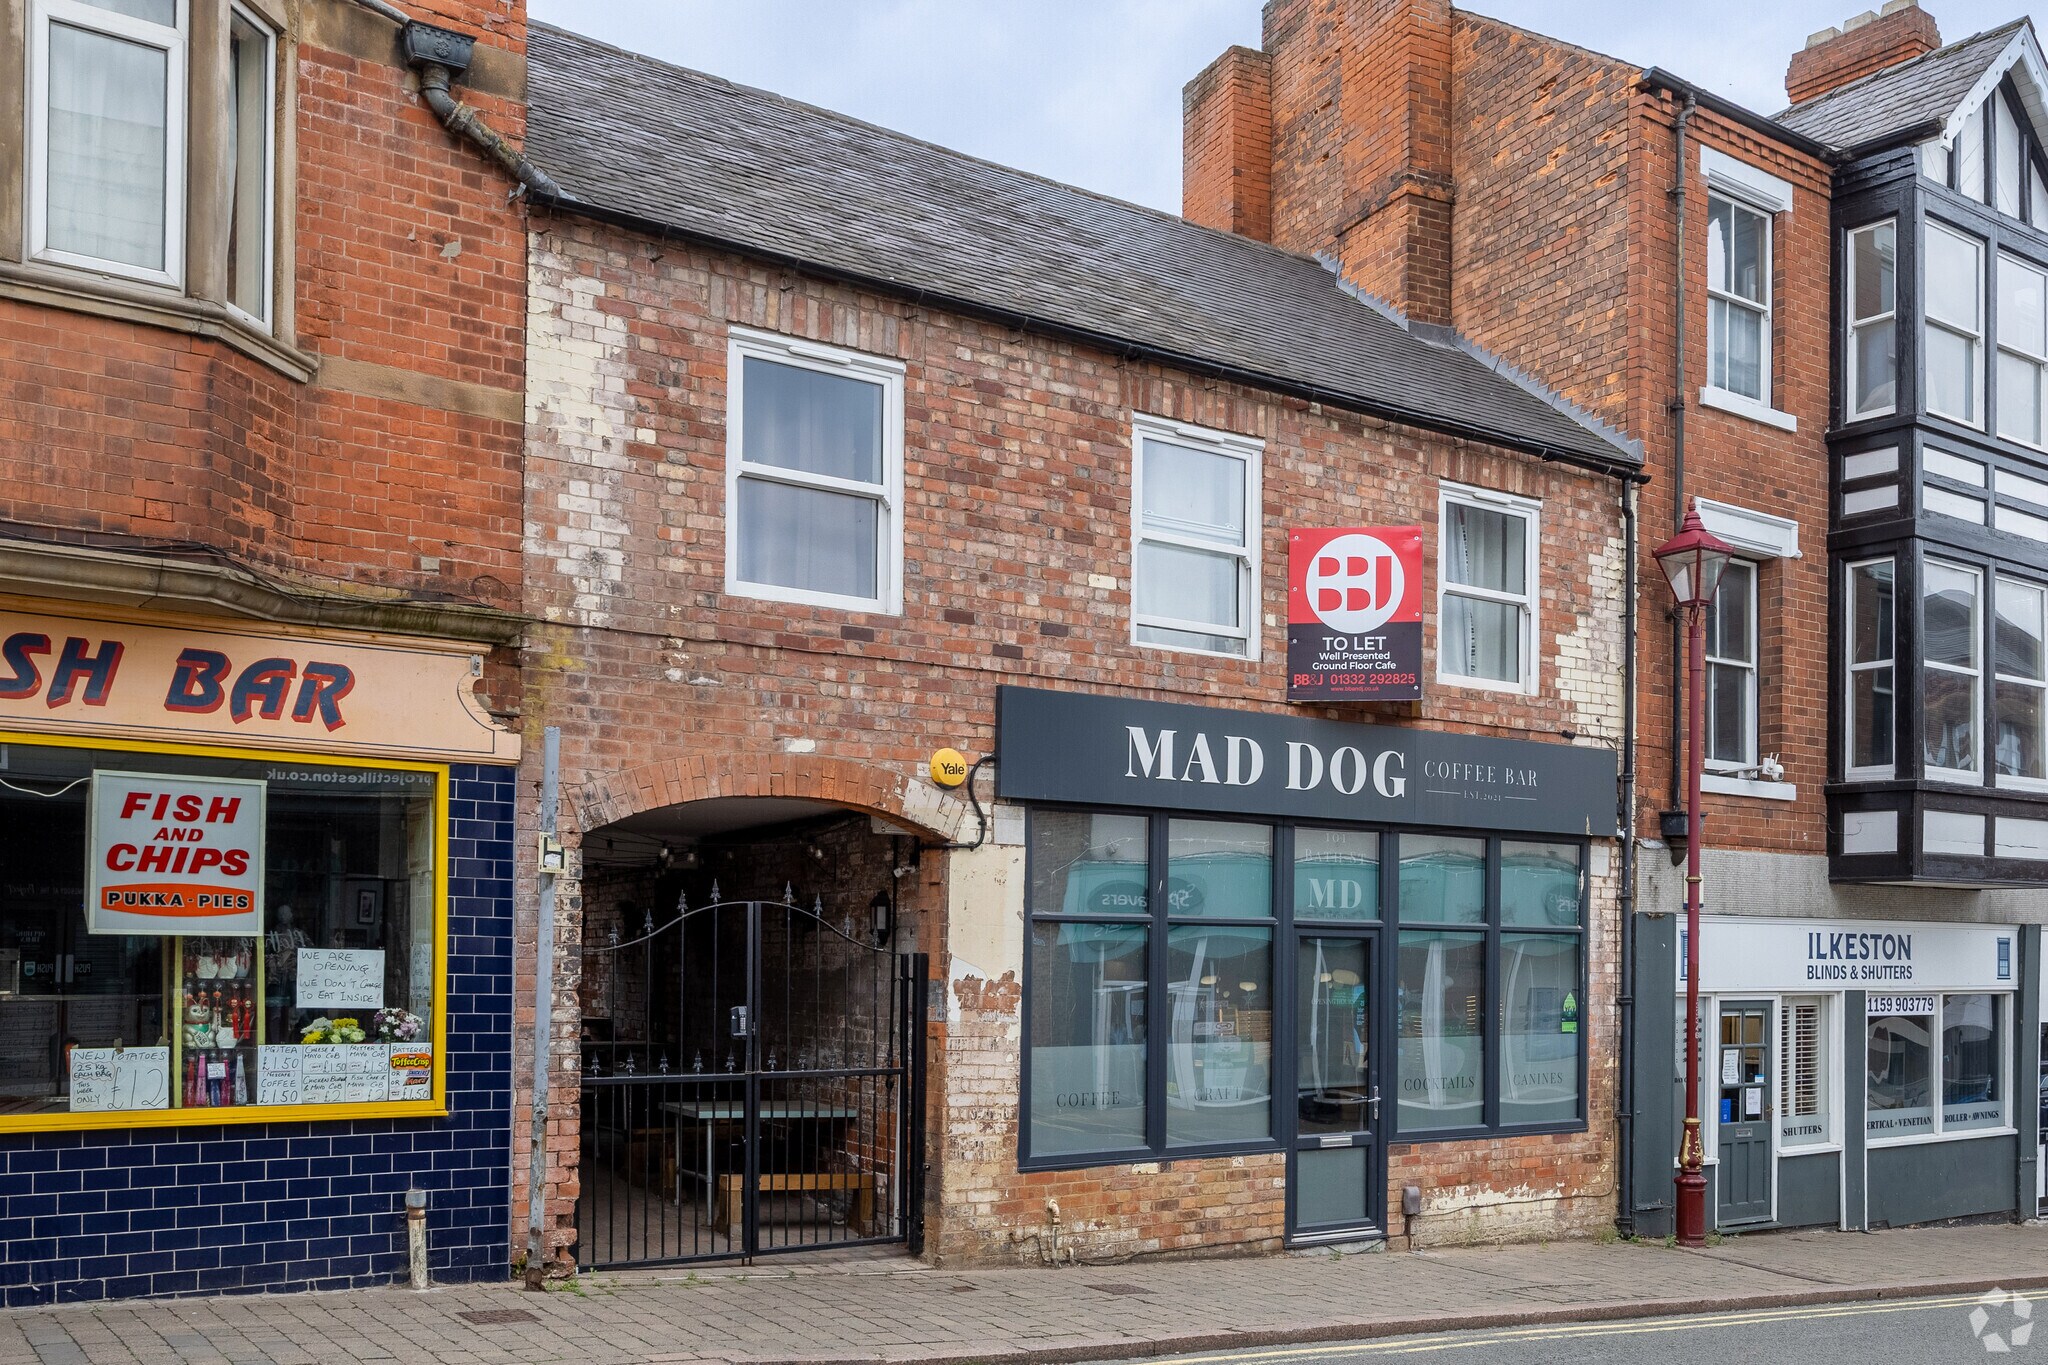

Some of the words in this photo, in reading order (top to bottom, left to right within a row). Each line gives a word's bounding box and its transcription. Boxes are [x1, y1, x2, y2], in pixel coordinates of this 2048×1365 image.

[1322, 636, 1348, 651] TO
[1353, 636, 1387, 651] LET
[1319, 651, 1340, 660] Well
[1342, 651, 1390, 660] Presented
[1312, 661, 1347, 671] Ground
[1349, 661, 1373, 670] Floor
[1375, 660, 1397, 670] Cafe
[1293, 673, 1324, 686] BB&J
[1330, 673, 1366, 685] 01332
[1369, 673, 1416, 685] 292825
[164, 647, 356, 732] BAR
[1124, 725, 1264, 786] MAD
[1285, 741, 1407, 798] DOG
[940, 762, 965, 775] Yale
[1424, 760, 1496, 783] COFFEE
[1505, 767, 1538, 787] BAR
[120, 791, 242, 824] FISH
[153, 827, 204, 842] AND
[106, 843, 250, 876] CHIPS
[1307, 878, 1362, 909] MD
[1808, 932, 1912, 960] ILKESTON
[301, 951, 320, 960] WE
[328, 951, 353, 962] ARE
[1807, 965, 1847, 980] BLINDS
[1850, 965, 1859, 980] &
[1861, 965, 1913, 980] SHUTTERS
[300, 979, 318, 988] WE
[300, 991, 313, 1000] TO
[318, 990, 335, 1000] EAT
[1895, 997, 1934, 1012] 903779
[73, 1051, 106, 1060] NEW
[392, 1045, 431, 1053] BATTERED
[77, 1064, 92, 1072] 25
[95, 1071, 112, 1079] BAG
[1513, 1072, 1563, 1086] CANINES
[107, 1066, 166, 1109] £12
[261, 1078, 297, 1088] COFFEE
[1404, 1076, 1475, 1091] COCKTAILS
[76, 1094, 101, 1105] ONLY
[1056, 1090, 1120, 1108] COFFEE
[1898, 1116, 1932, 1127] VENETIAN
[1944, 1113, 1968, 1123] ROLLER
[1972, 1110, 2000, 1121] AWNINGS
[1783, 1124, 1822, 1137] SHUTTERS
